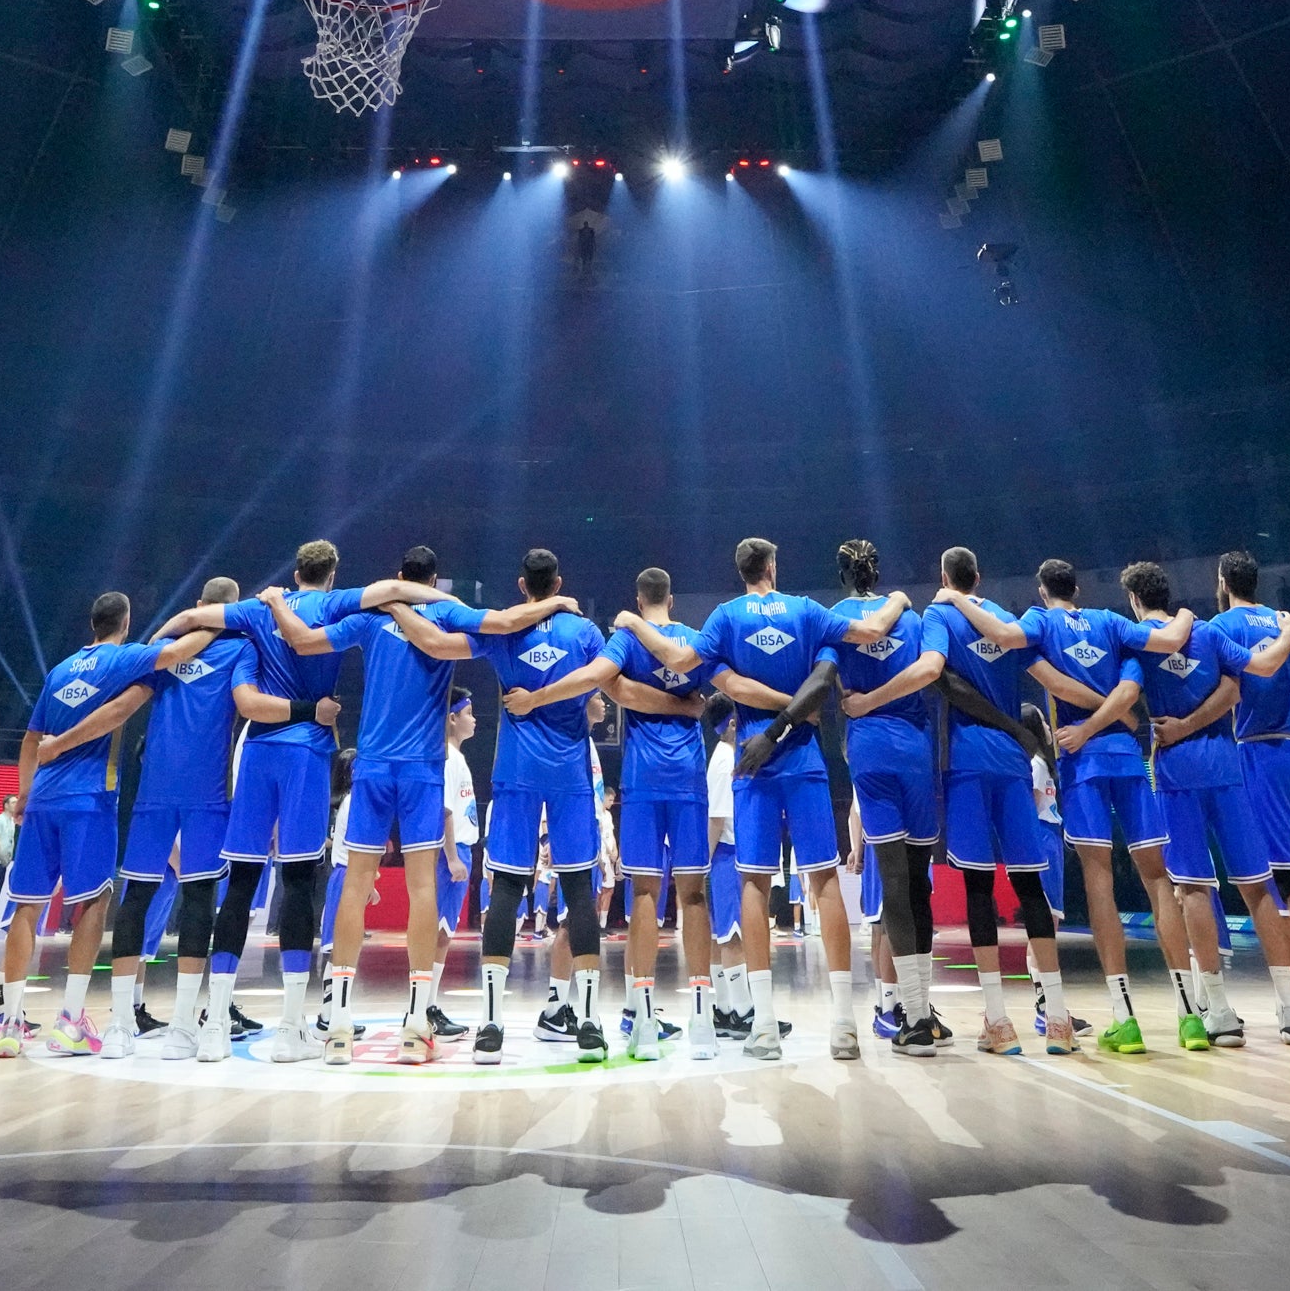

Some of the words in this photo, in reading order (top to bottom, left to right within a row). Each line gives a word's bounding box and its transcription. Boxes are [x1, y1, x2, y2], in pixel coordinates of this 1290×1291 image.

[755, 634, 785, 646] IBSA
[866, 640, 895, 653] IBSA
[976, 642, 1003, 655] IBSA
[1074, 648, 1099, 660] IBSA
[529, 649, 558, 663] IBSA
[175, 662, 204, 676] IBSA
[1168, 658, 1193, 671] IBSA
[61, 686, 90, 700] IBSA
